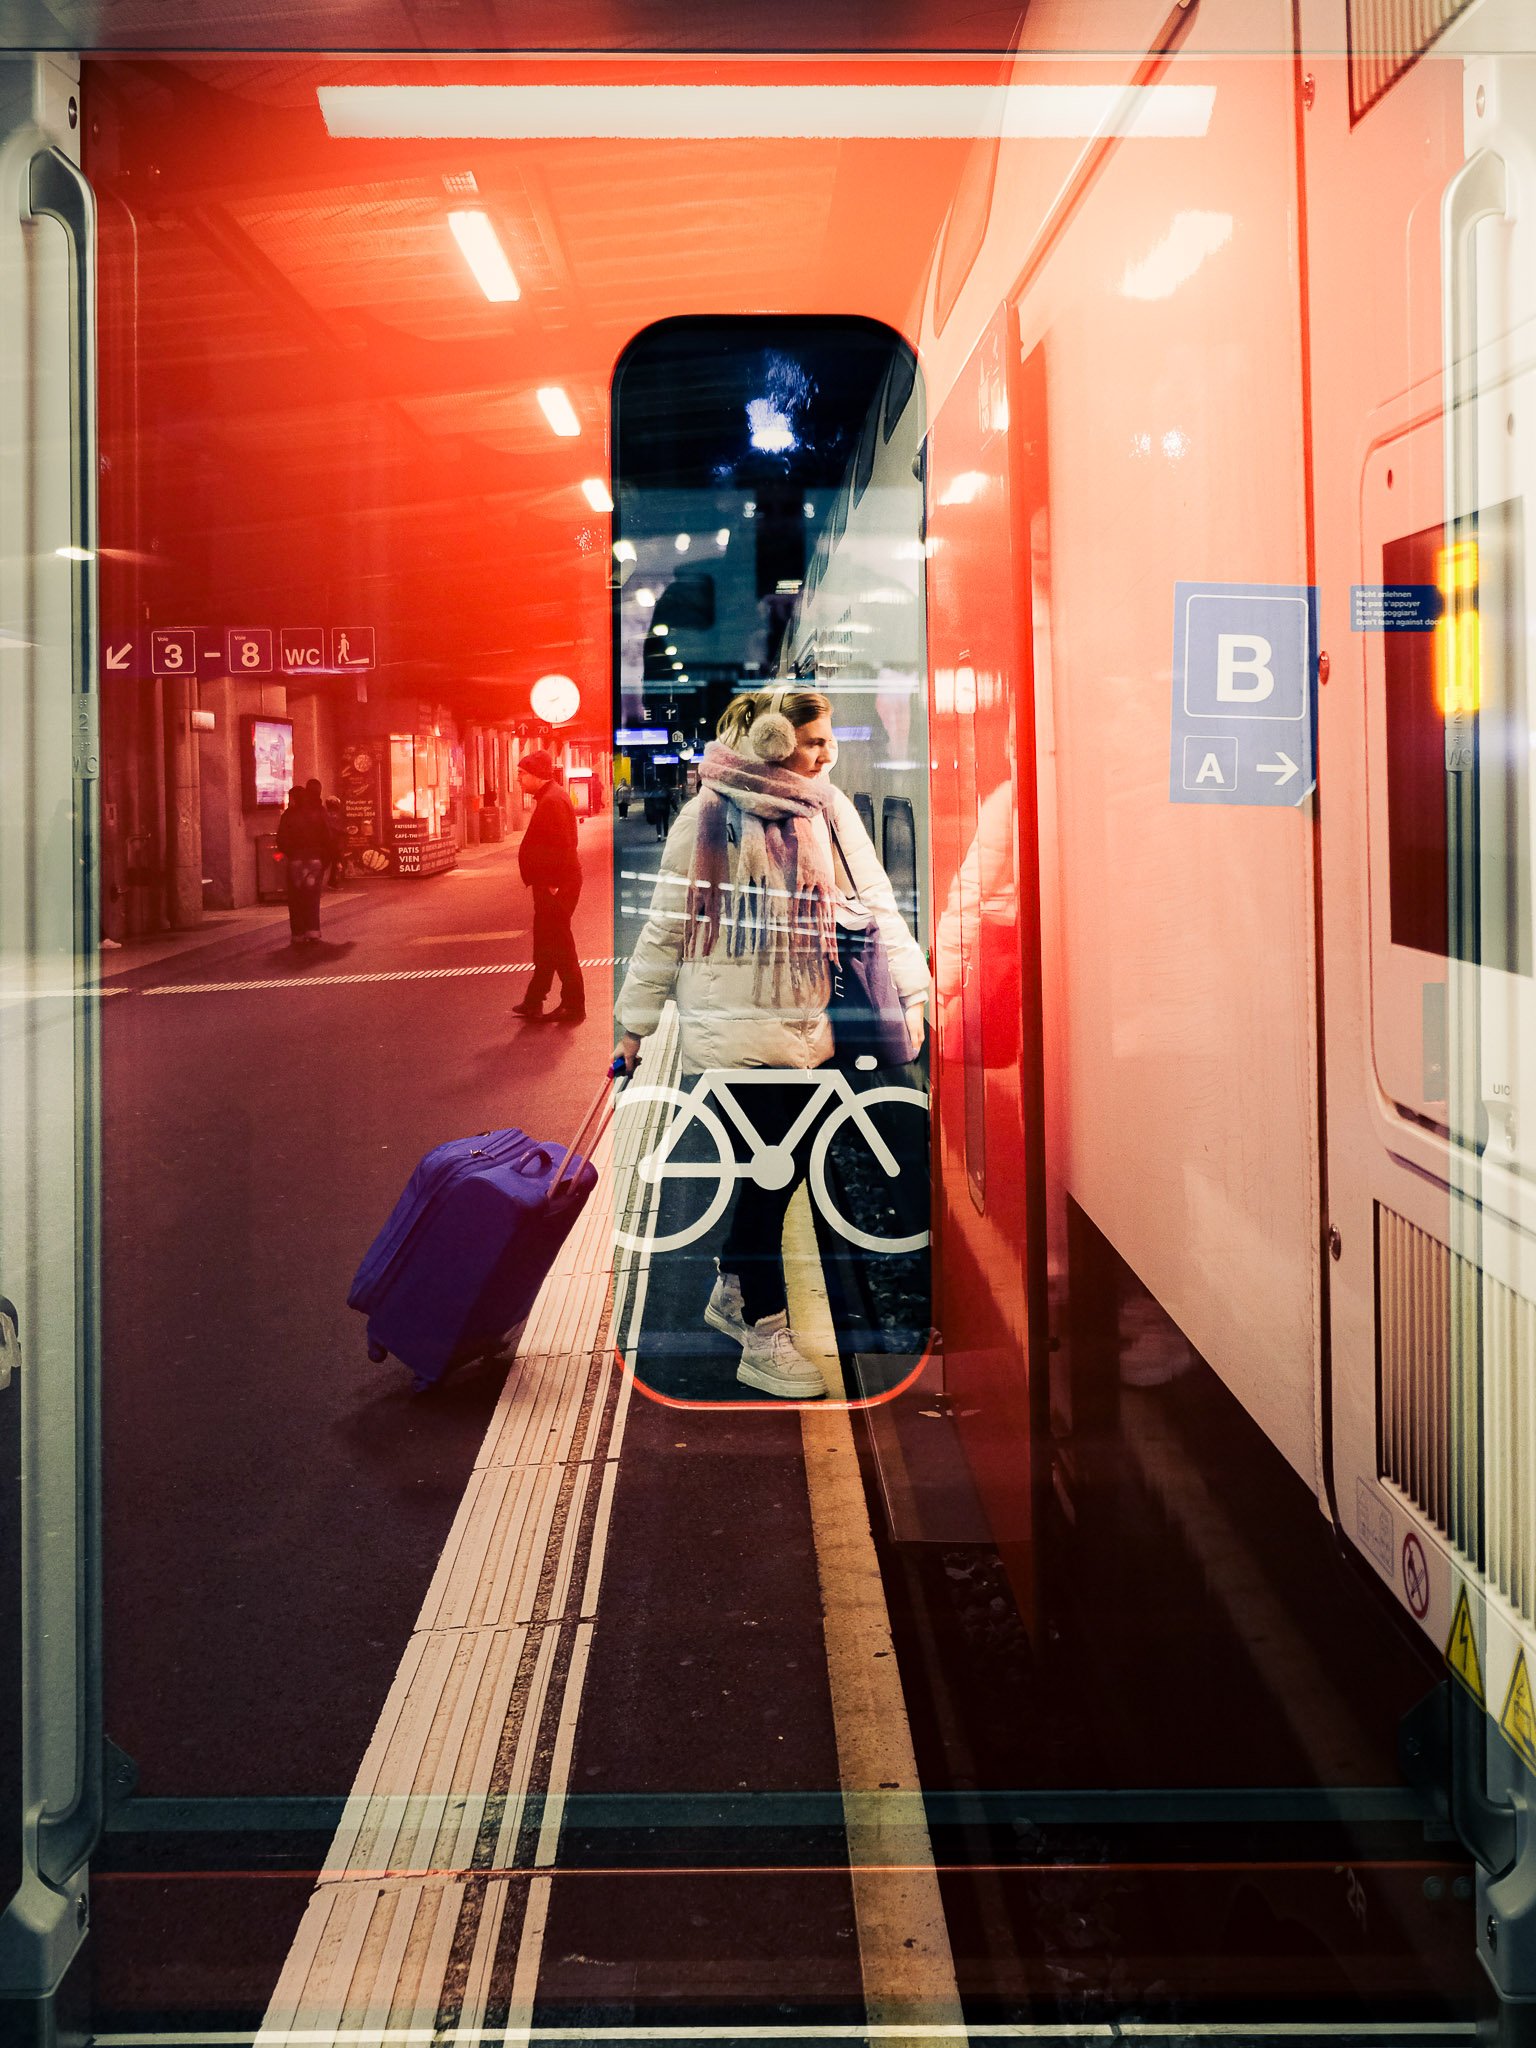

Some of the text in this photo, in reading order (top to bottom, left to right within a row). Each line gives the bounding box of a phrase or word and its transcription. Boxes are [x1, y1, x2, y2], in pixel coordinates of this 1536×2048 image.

[1372, 609, 1417, 617] appoggiarsi
[1395, 619, 1424, 627] against
[164, 644, 184, 669] 3
[241, 642, 260, 668] 8
[284, 647, 321, 667] WC
[1216, 633, 1275, 703] B
[643, 709, 652, 721] E
[1195, 752, 1225, 784] A
[398, 846, 420, 854] PATIS
[399, 855, 420, 863] VIEN
[1493, 1084, 1511, 1096] UIC
